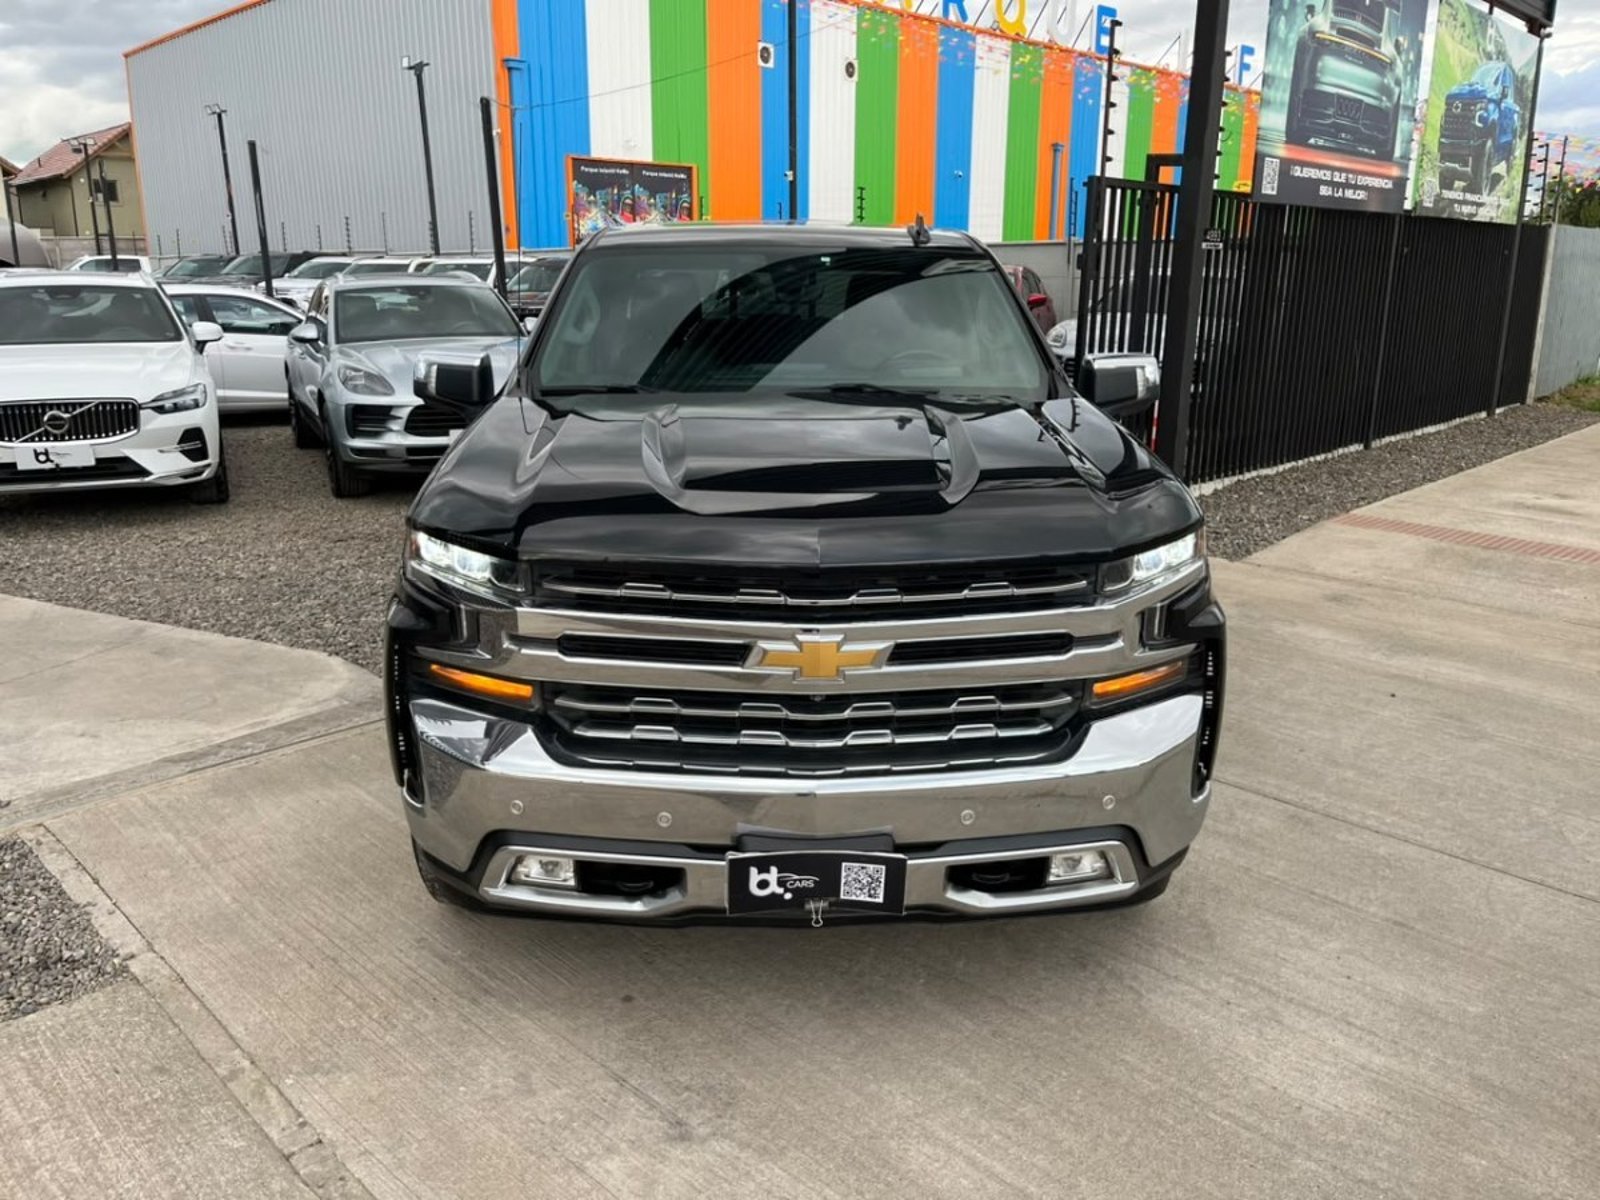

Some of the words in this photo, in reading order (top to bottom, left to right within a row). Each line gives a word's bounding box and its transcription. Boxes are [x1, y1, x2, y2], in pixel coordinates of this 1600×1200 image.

[1333, 171, 1347, 183] QUE
[1319, 185, 1332, 196] SEA
[1334, 187, 1343, 198] LA
[786, 880, 815, 889] CARS
